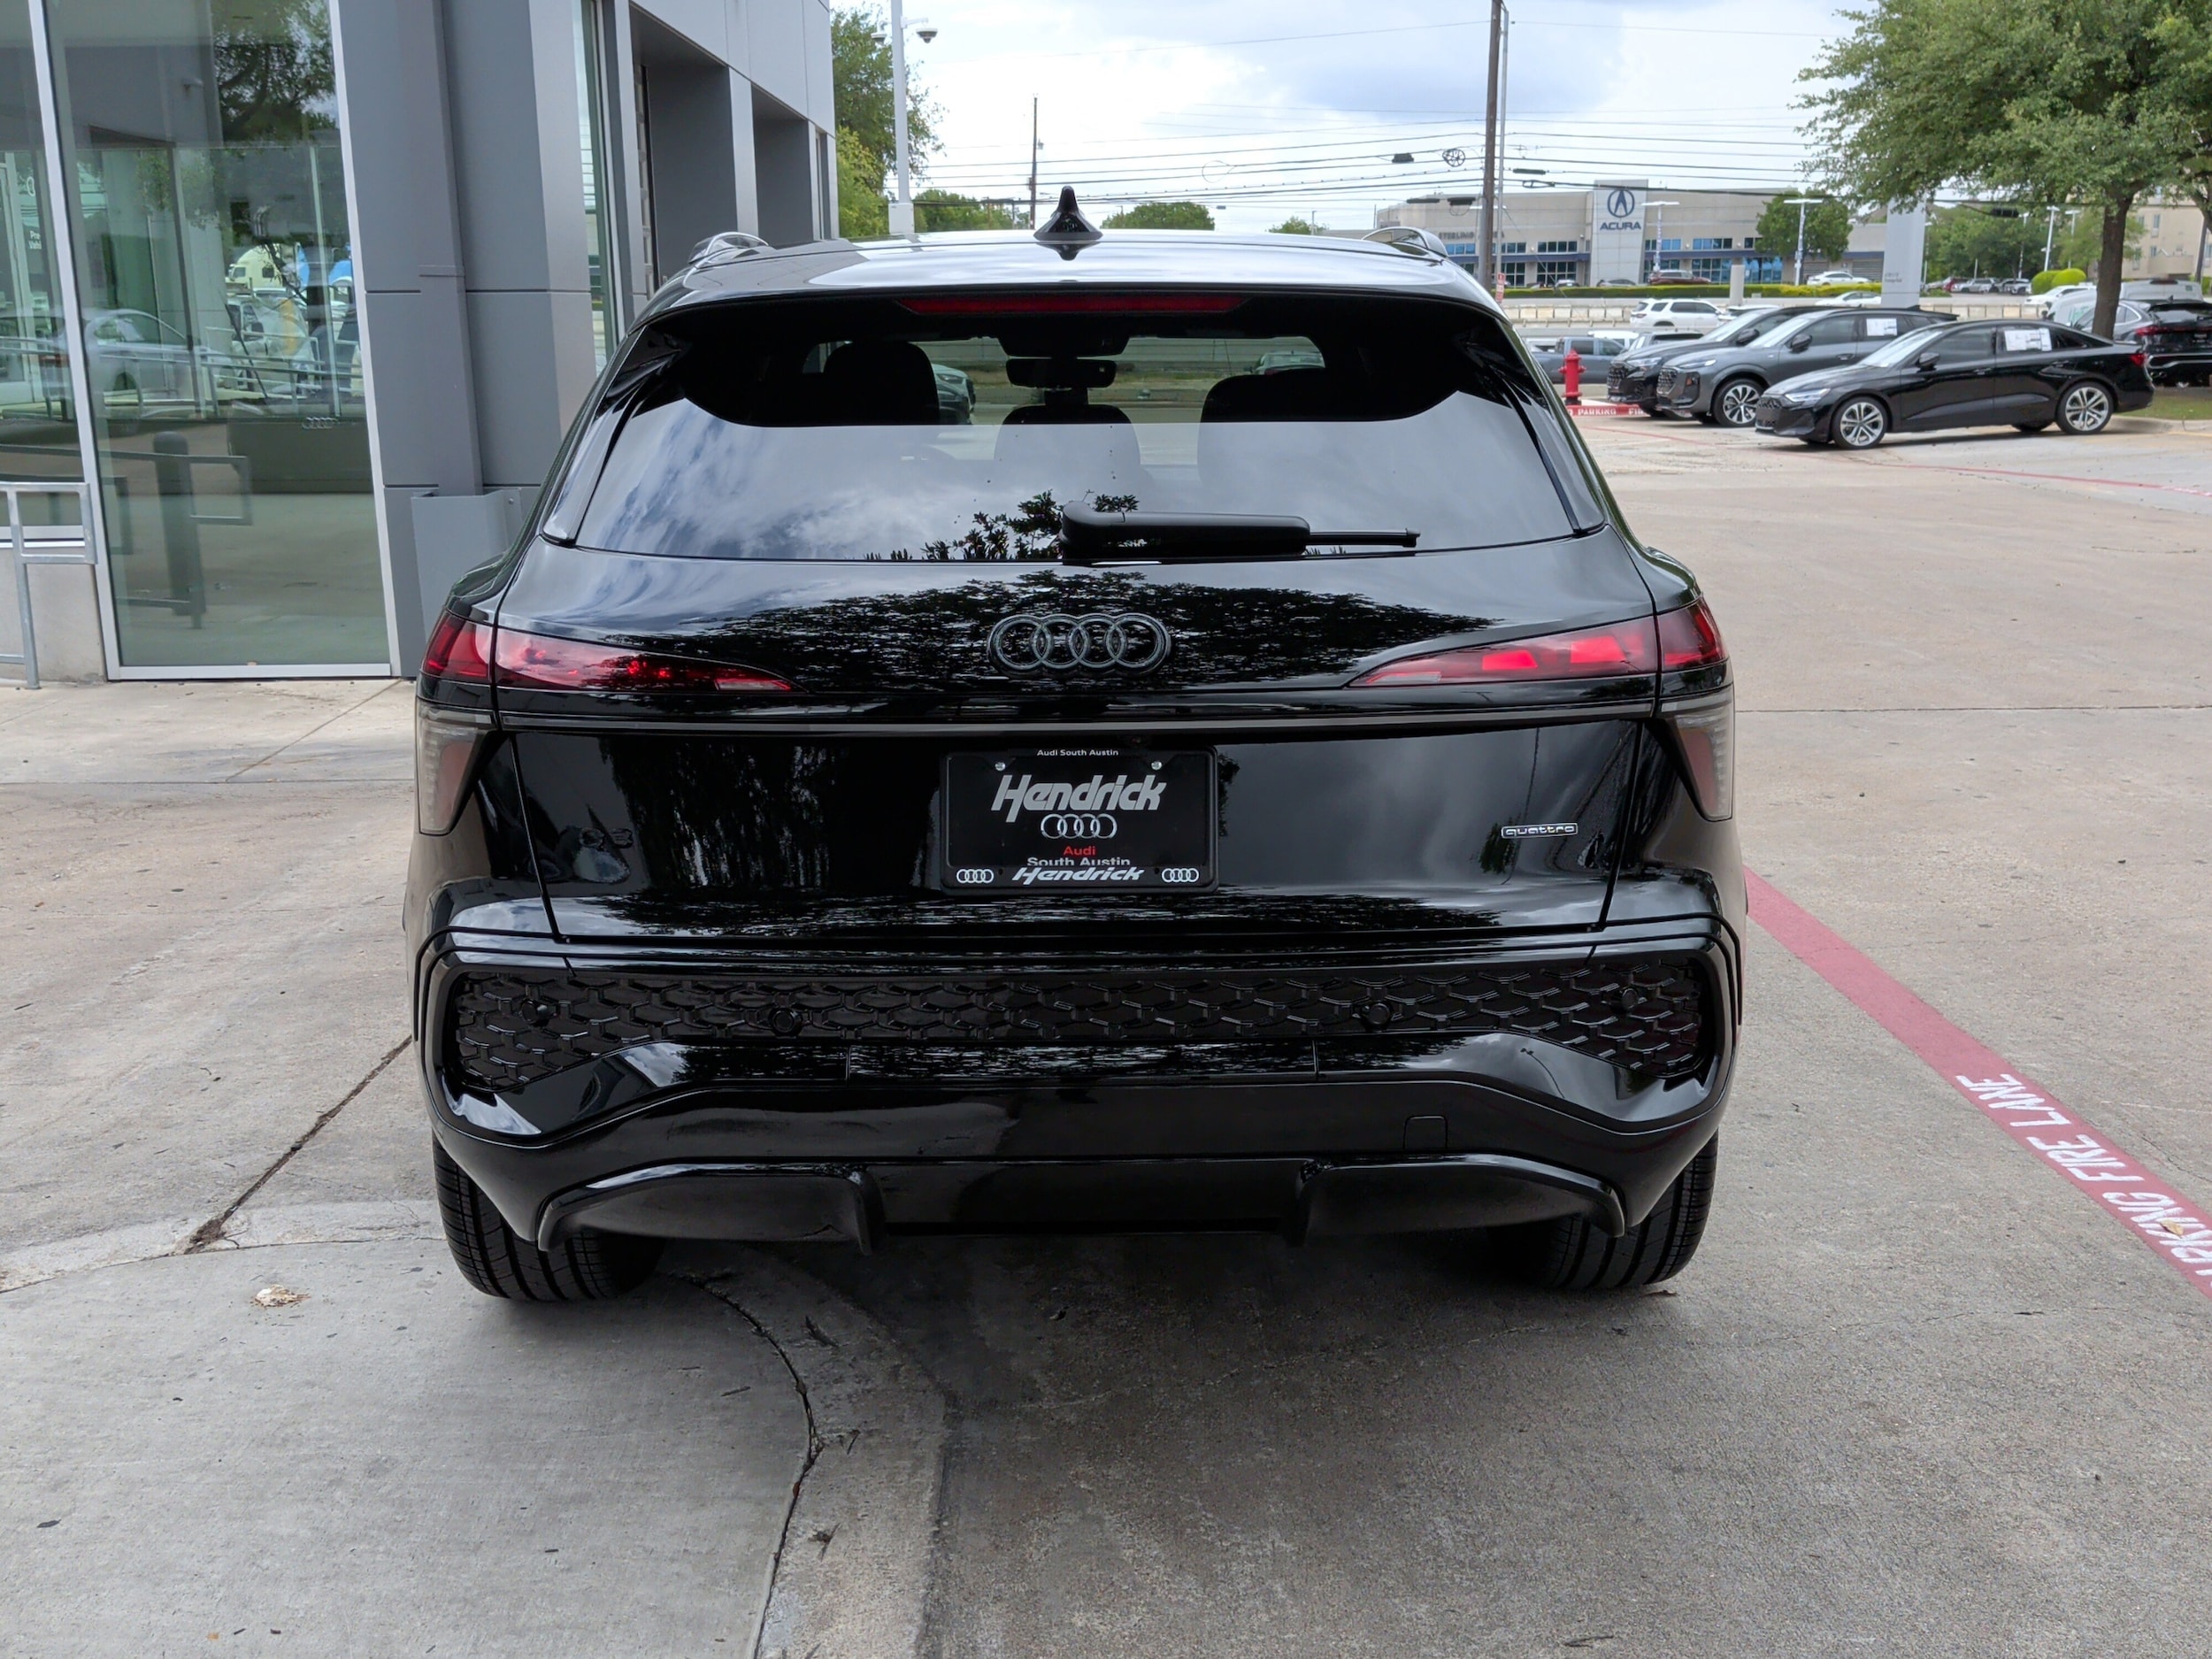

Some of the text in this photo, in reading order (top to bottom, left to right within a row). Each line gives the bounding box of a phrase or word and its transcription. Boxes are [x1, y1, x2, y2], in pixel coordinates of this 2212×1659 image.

[1600, 221, 1641, 230] ACURA
[990, 775, 1167, 823] Hendrick
[1505, 826, 1575, 837] quattro
[1064, 846, 1095, 856] Audi
[1026, 856, 1131, 866] South Austin
[1011, 867, 1145, 885] Hendrick
[1955, 1073, 2071, 1126] LANE
[2026, 1133, 2145, 1181] FIRE
